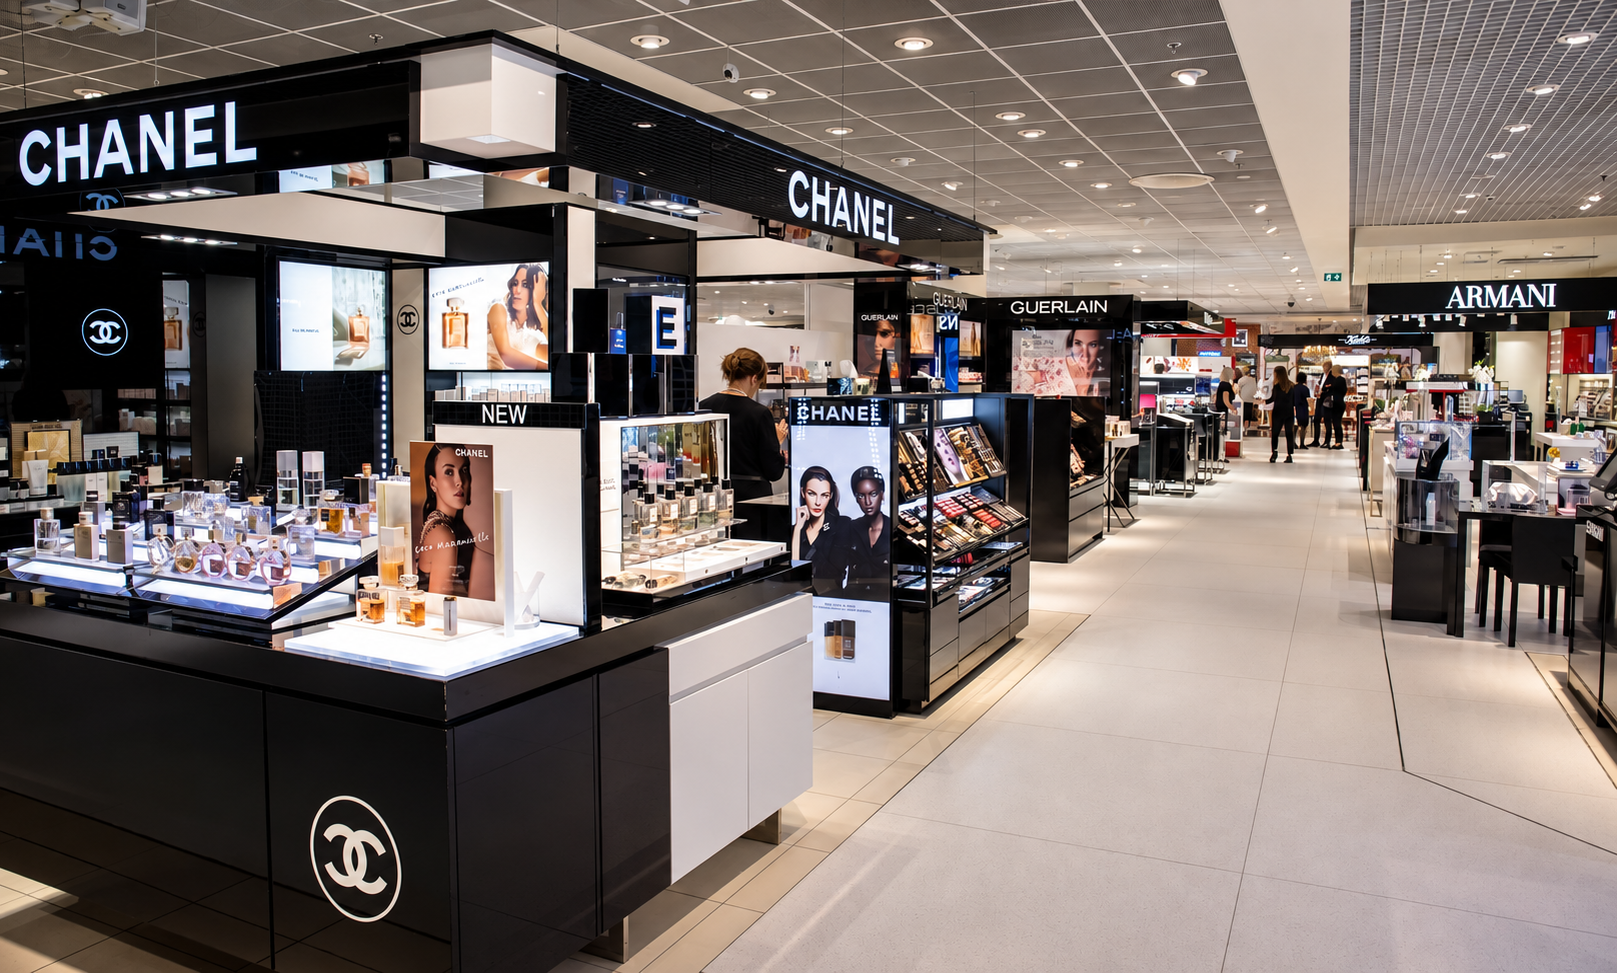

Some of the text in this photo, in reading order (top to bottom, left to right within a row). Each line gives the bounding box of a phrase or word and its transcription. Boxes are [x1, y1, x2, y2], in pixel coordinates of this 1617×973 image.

[19, 101, 257, 187] CHANEL
[788, 170, 900, 245] CHANEL
[1445, 283, 1557, 309] ARMANI
[1009, 299, 1108, 314] GUERLAIN
[860, 313, 899, 321] GUERLAIN
[656, 306, 678, 349] E
[481, 404, 528, 424] NEW
[797, 405, 882, 421] CHANEL
[455, 448, 489, 458] CHANEL
